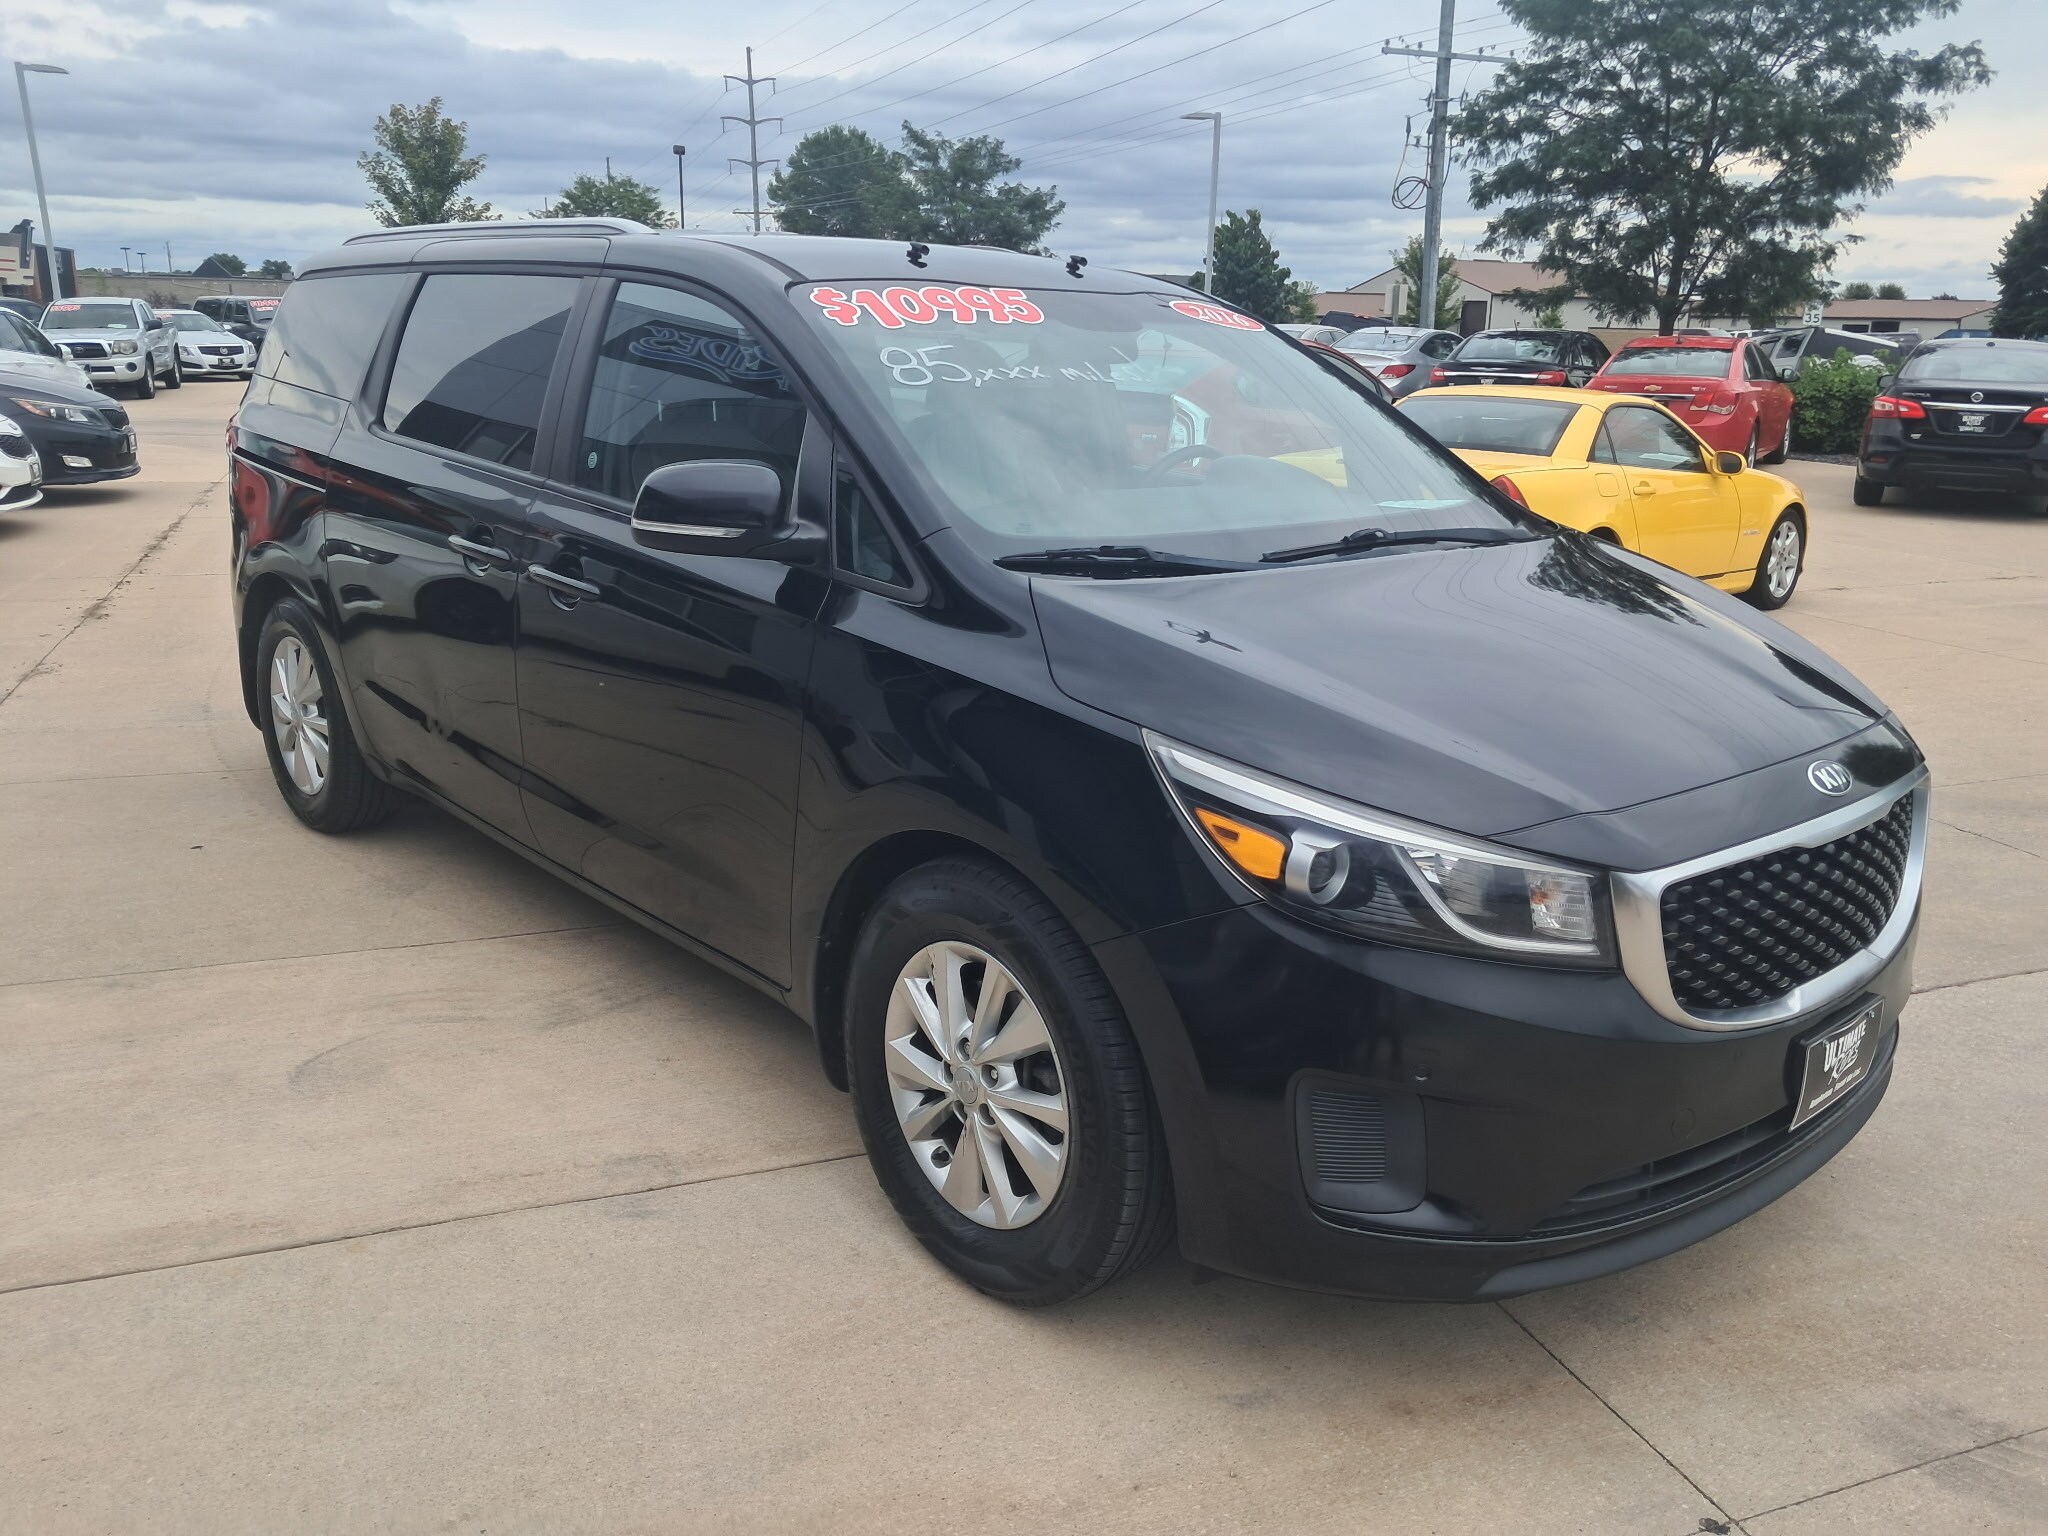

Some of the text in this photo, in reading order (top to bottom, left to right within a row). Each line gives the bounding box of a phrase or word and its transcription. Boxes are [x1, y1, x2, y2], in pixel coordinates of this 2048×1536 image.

[809, 287, 1044, 329] $10995
[1189, 305, 1250, 327] 2016
[1805, 313, 1820, 323] 35
[1823, 1019, 1867, 1073] ULTIMATE
